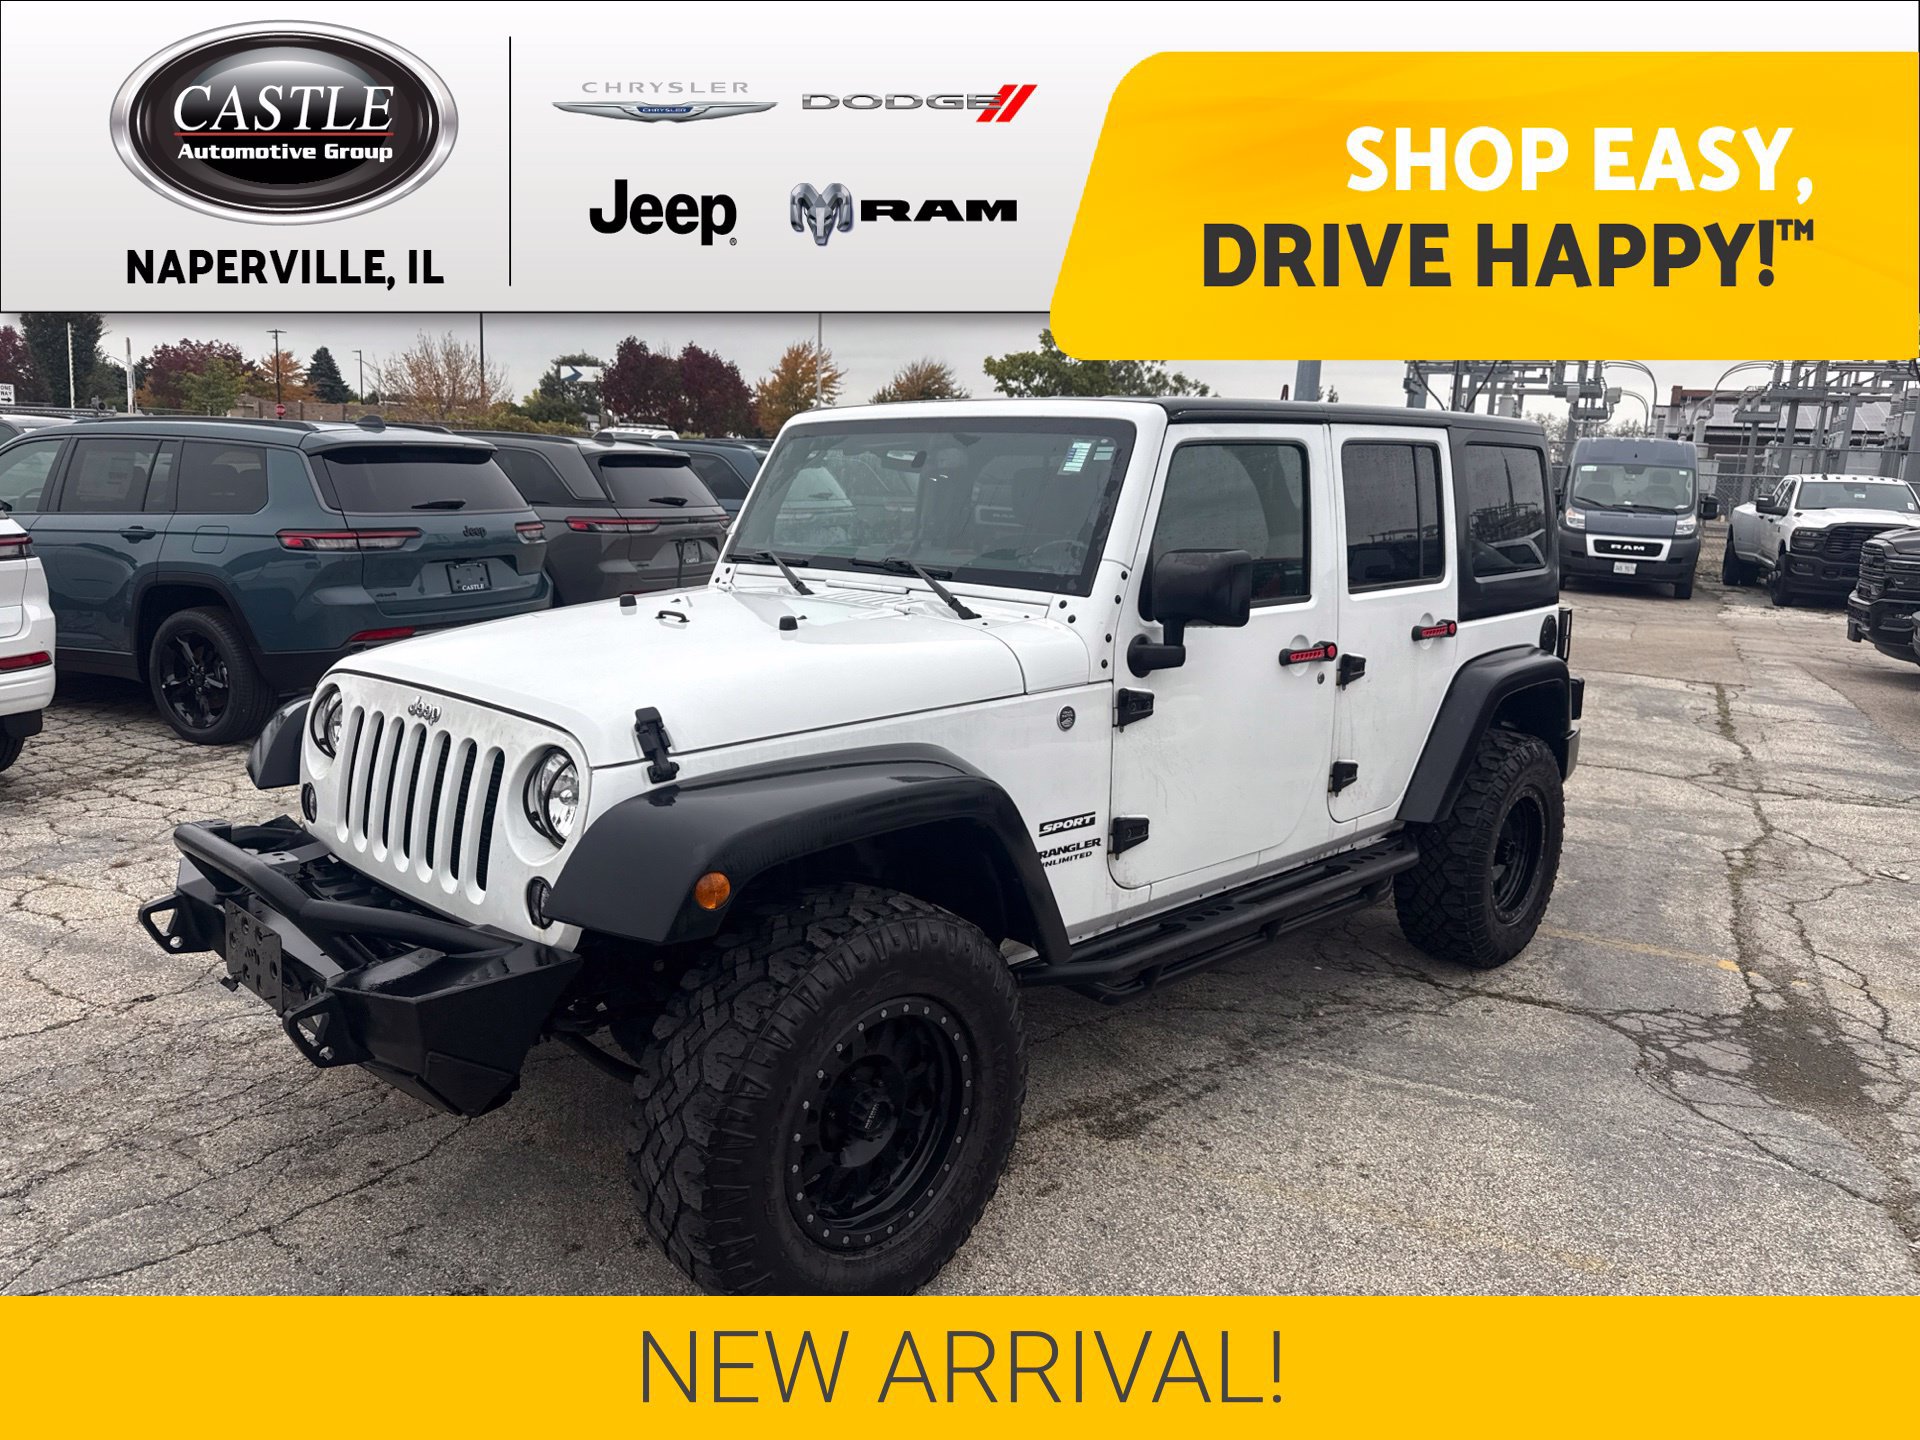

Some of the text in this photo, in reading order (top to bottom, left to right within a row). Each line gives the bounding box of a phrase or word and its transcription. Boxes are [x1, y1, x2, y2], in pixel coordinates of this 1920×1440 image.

[462, 525, 488, 538] Jeep
[1610, 543, 1646, 551] RAM
[461, 583, 485, 592] CASTLE
[407, 694, 443, 727] Jeep
[1041, 815, 1093, 833] SPORT
[1039, 838, 1101, 859] RANGLER
